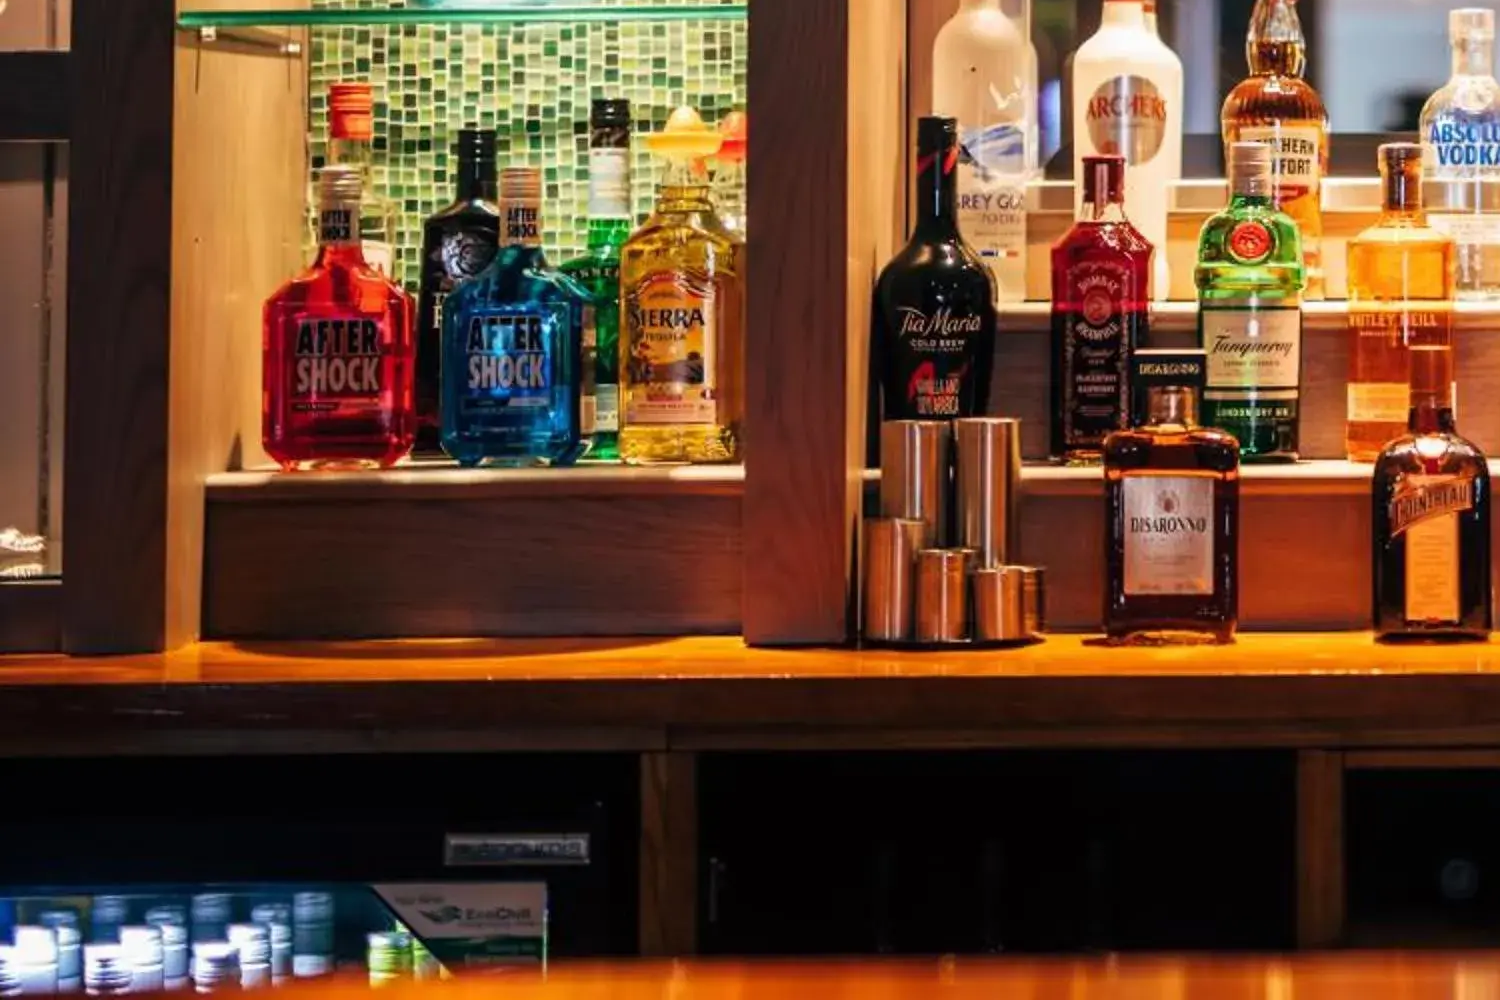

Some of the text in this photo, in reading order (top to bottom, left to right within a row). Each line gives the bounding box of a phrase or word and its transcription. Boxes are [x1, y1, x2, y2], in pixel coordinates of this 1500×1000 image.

[957, 194, 992, 209] REY
[321, 209, 350, 224] AFTER
[507, 207, 537, 222] AFTER
[1077, 275, 1120, 295] BOMBAY
[630, 308, 706, 329] SIERRA
[896, 306, 981, 337] Tia Maria
[295, 319, 381, 356] AFTER
[466, 316, 546, 353] AFTER
[1213, 335, 1293, 358] Tanqueray
[297, 358, 380, 393] SHOCK
[468, 355, 545, 389] SHOCK
[1129, 516, 1207, 535] DISARONNO
